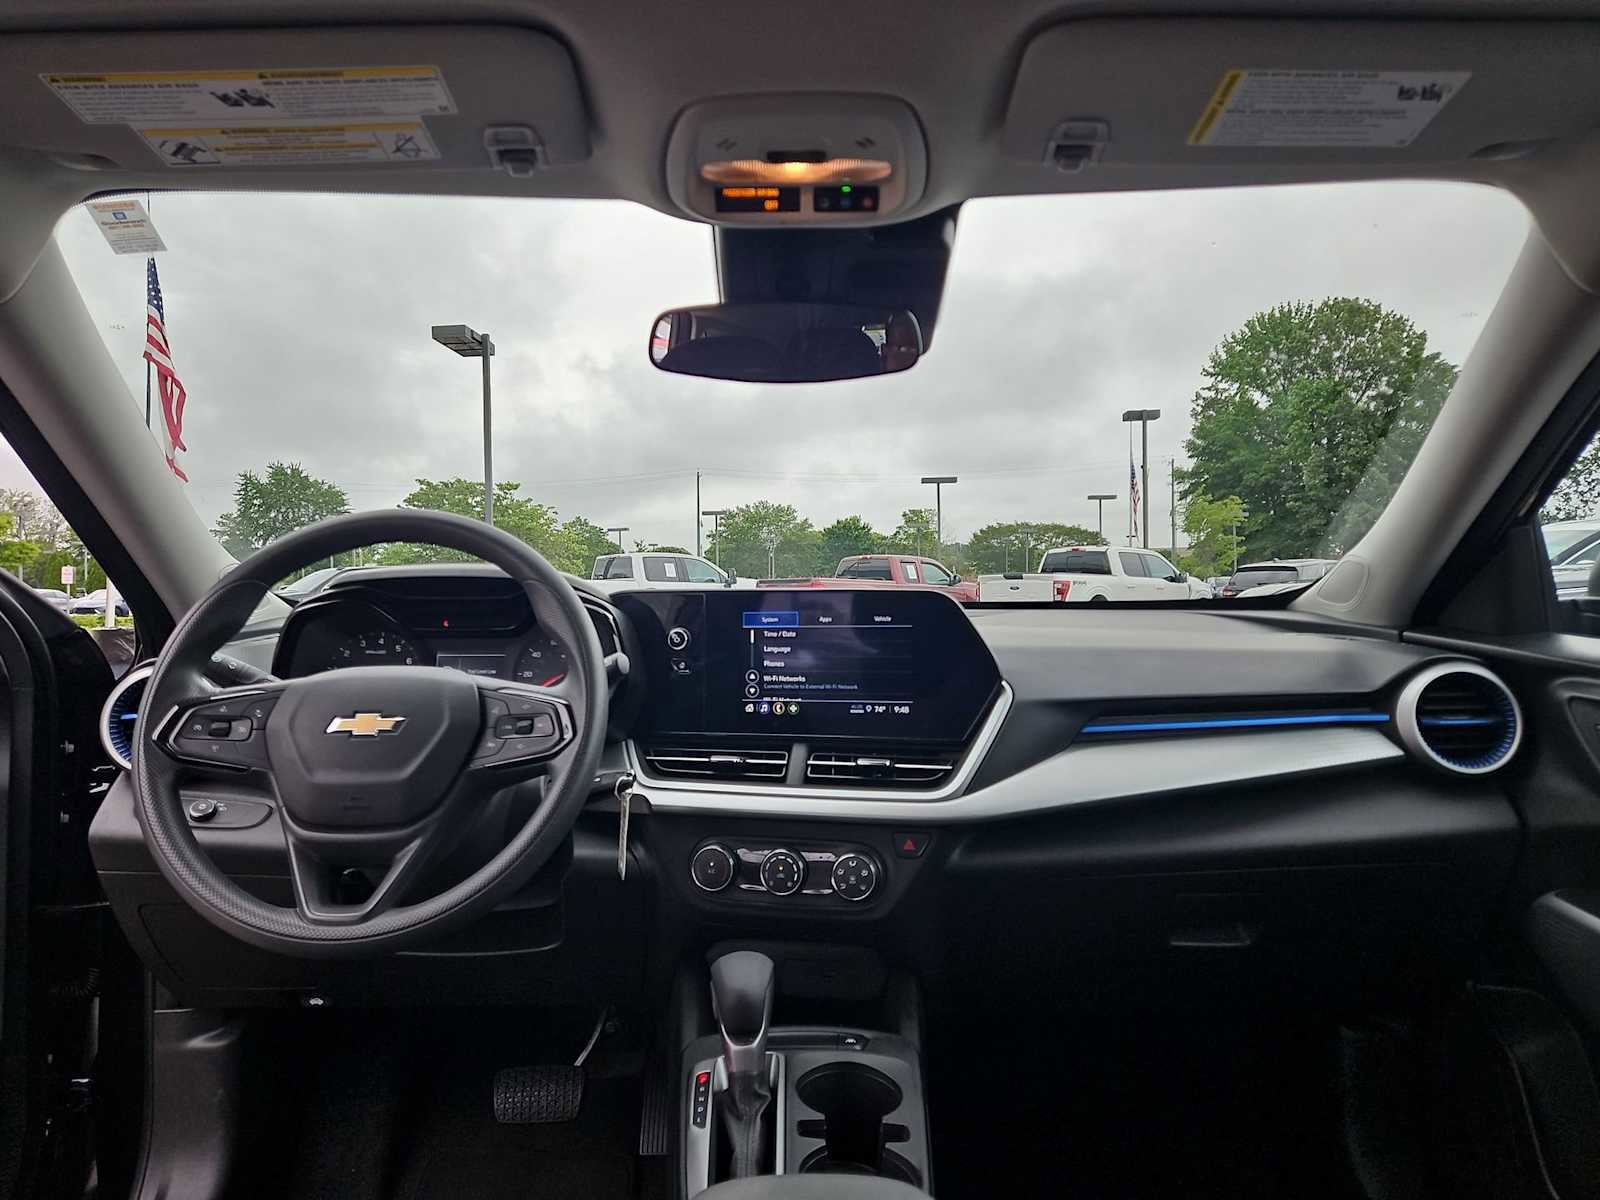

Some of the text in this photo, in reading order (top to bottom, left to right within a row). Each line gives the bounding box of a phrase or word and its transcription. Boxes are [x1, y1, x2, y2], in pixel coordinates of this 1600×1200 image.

[761, 615, 779, 624] System
[818, 615, 833, 624] Apps
[763, 630, 778, 638] Time
[763, 645, 792, 654] Language
[763, 660, 785, 668] Phones
[763, 674, 807, 682] Wi-Fi Networks
